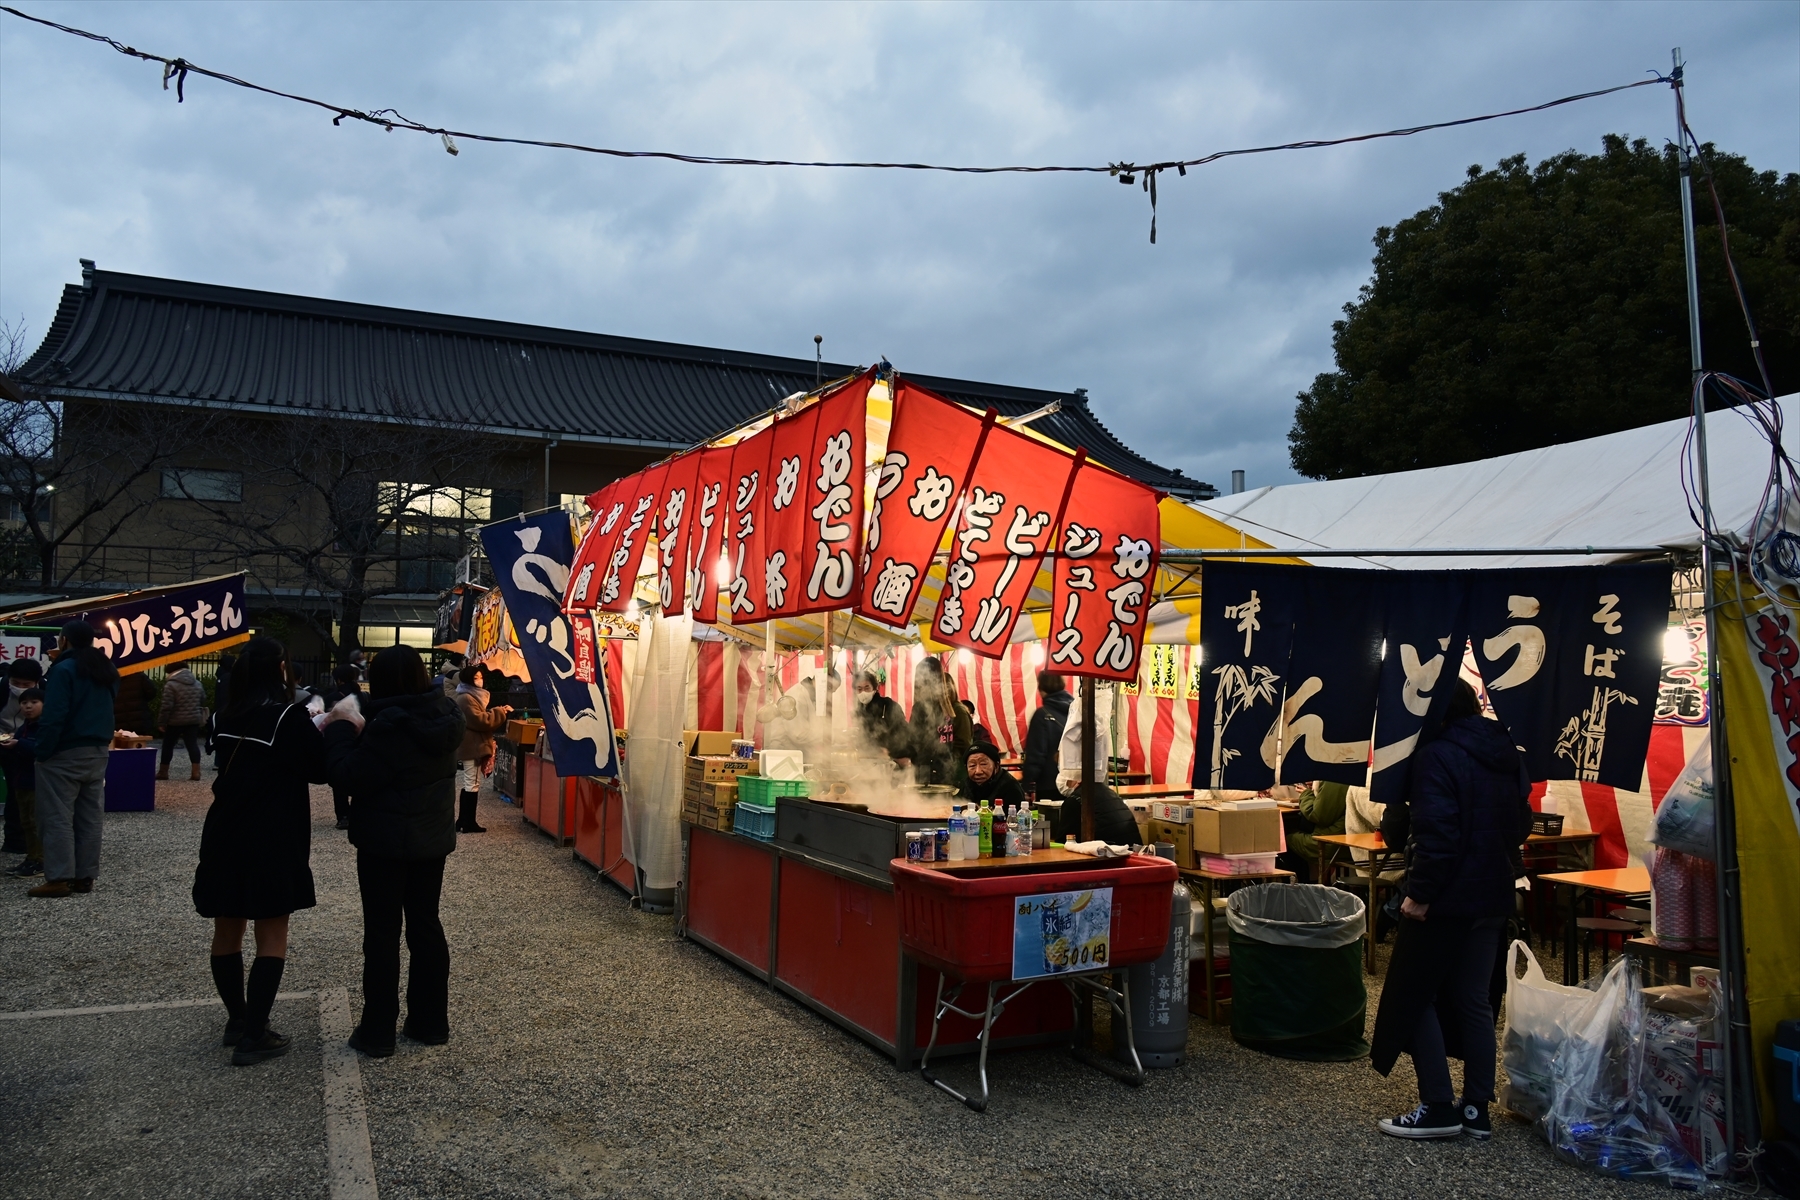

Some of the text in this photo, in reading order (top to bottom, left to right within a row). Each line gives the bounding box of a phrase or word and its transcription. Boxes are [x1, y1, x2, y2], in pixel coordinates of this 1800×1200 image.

[603, 494, 654, 603] どてやき
[660, 488, 686, 609] おでん
[690, 482, 721, 611] ビール
[729, 470, 759, 615] ジュース
[766, 454, 801, 610] お茶
[807, 429, 854, 601] おでん
[873, 465, 954, 616] お酒
[939, 486, 1005, 636] どてやき
[969, 505, 1050, 644] ビール
[1051, 522, 1102, 666] ジュース
[1094, 535, 1152, 671] おでん
[1224, 589, 1262, 658] 味
[1583, 593, 1625, 680] そば
[1045, 913, 1072, 934] 氷結
[1061, 943, 1107, 966] 500円
[1157, 975, 1170, 1025] 京都工場
[1657, 1095, 1694, 1124] ahi
